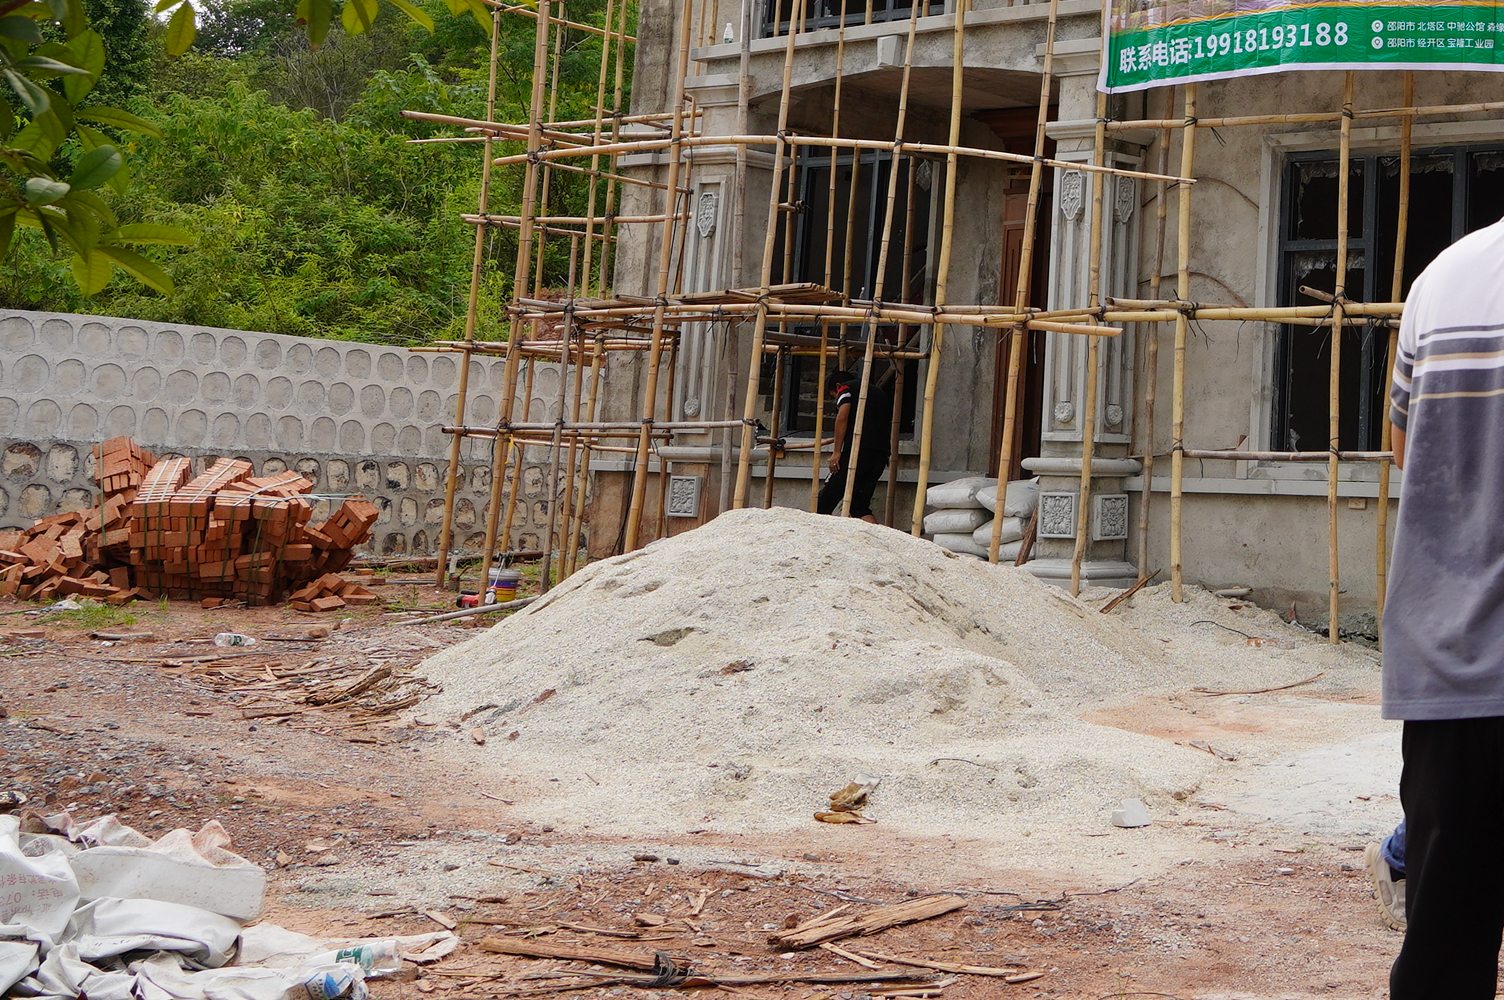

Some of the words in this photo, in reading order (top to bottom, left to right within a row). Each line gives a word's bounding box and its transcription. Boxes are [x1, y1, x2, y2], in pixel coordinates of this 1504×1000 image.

[1417, 21, 1445, 32] 北塔区
[1417, 38, 1445, 48] 经开区
